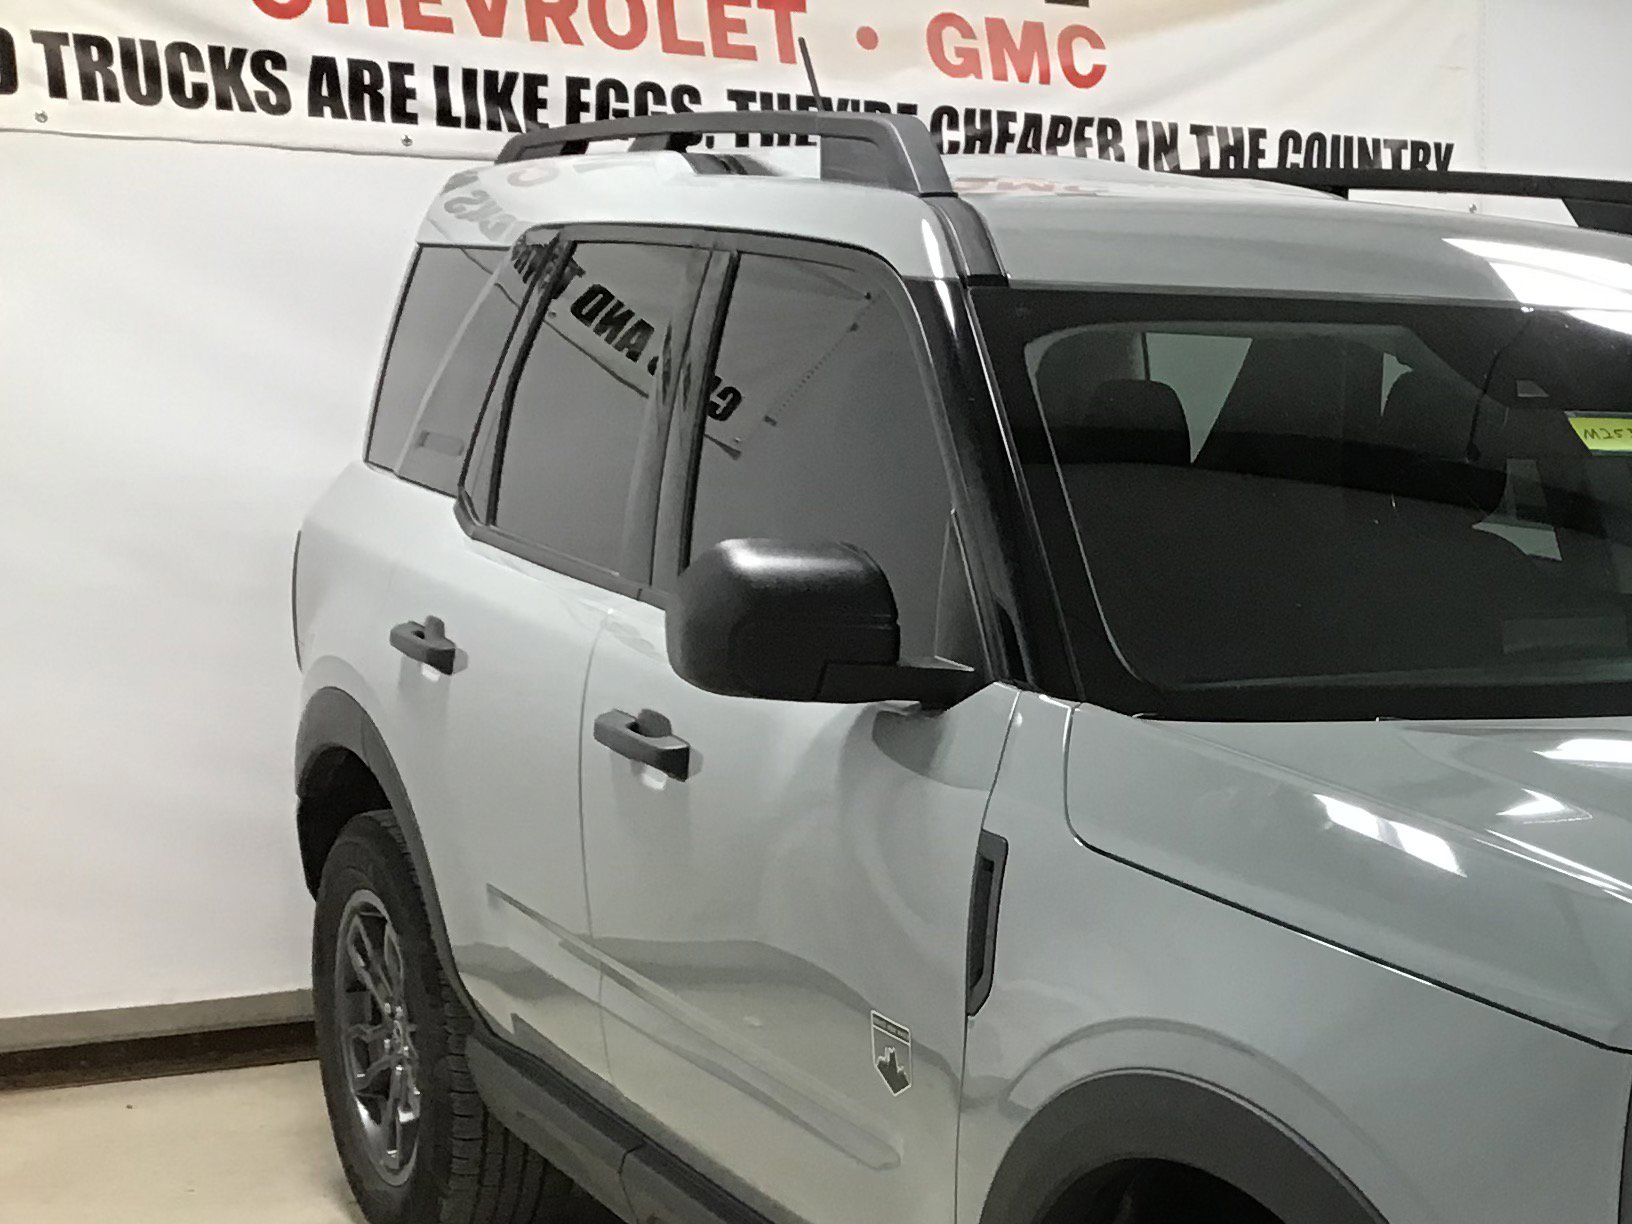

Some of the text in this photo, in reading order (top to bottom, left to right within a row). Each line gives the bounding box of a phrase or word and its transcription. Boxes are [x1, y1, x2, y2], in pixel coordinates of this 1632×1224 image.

[30, 29, 291, 116] TRUCKS
[307, 55, 418, 126] ARE
[433, 65, 550, 133] LIKE
[930, 105, 1126, 162] CHEAPER
[1135, 120, 1182, 172] IN
[1189, 124, 1268, 170] THE
[1276, 129, 1455, 171] COUNTRY
[254, 0, 1107, 89] VROLET GMC
